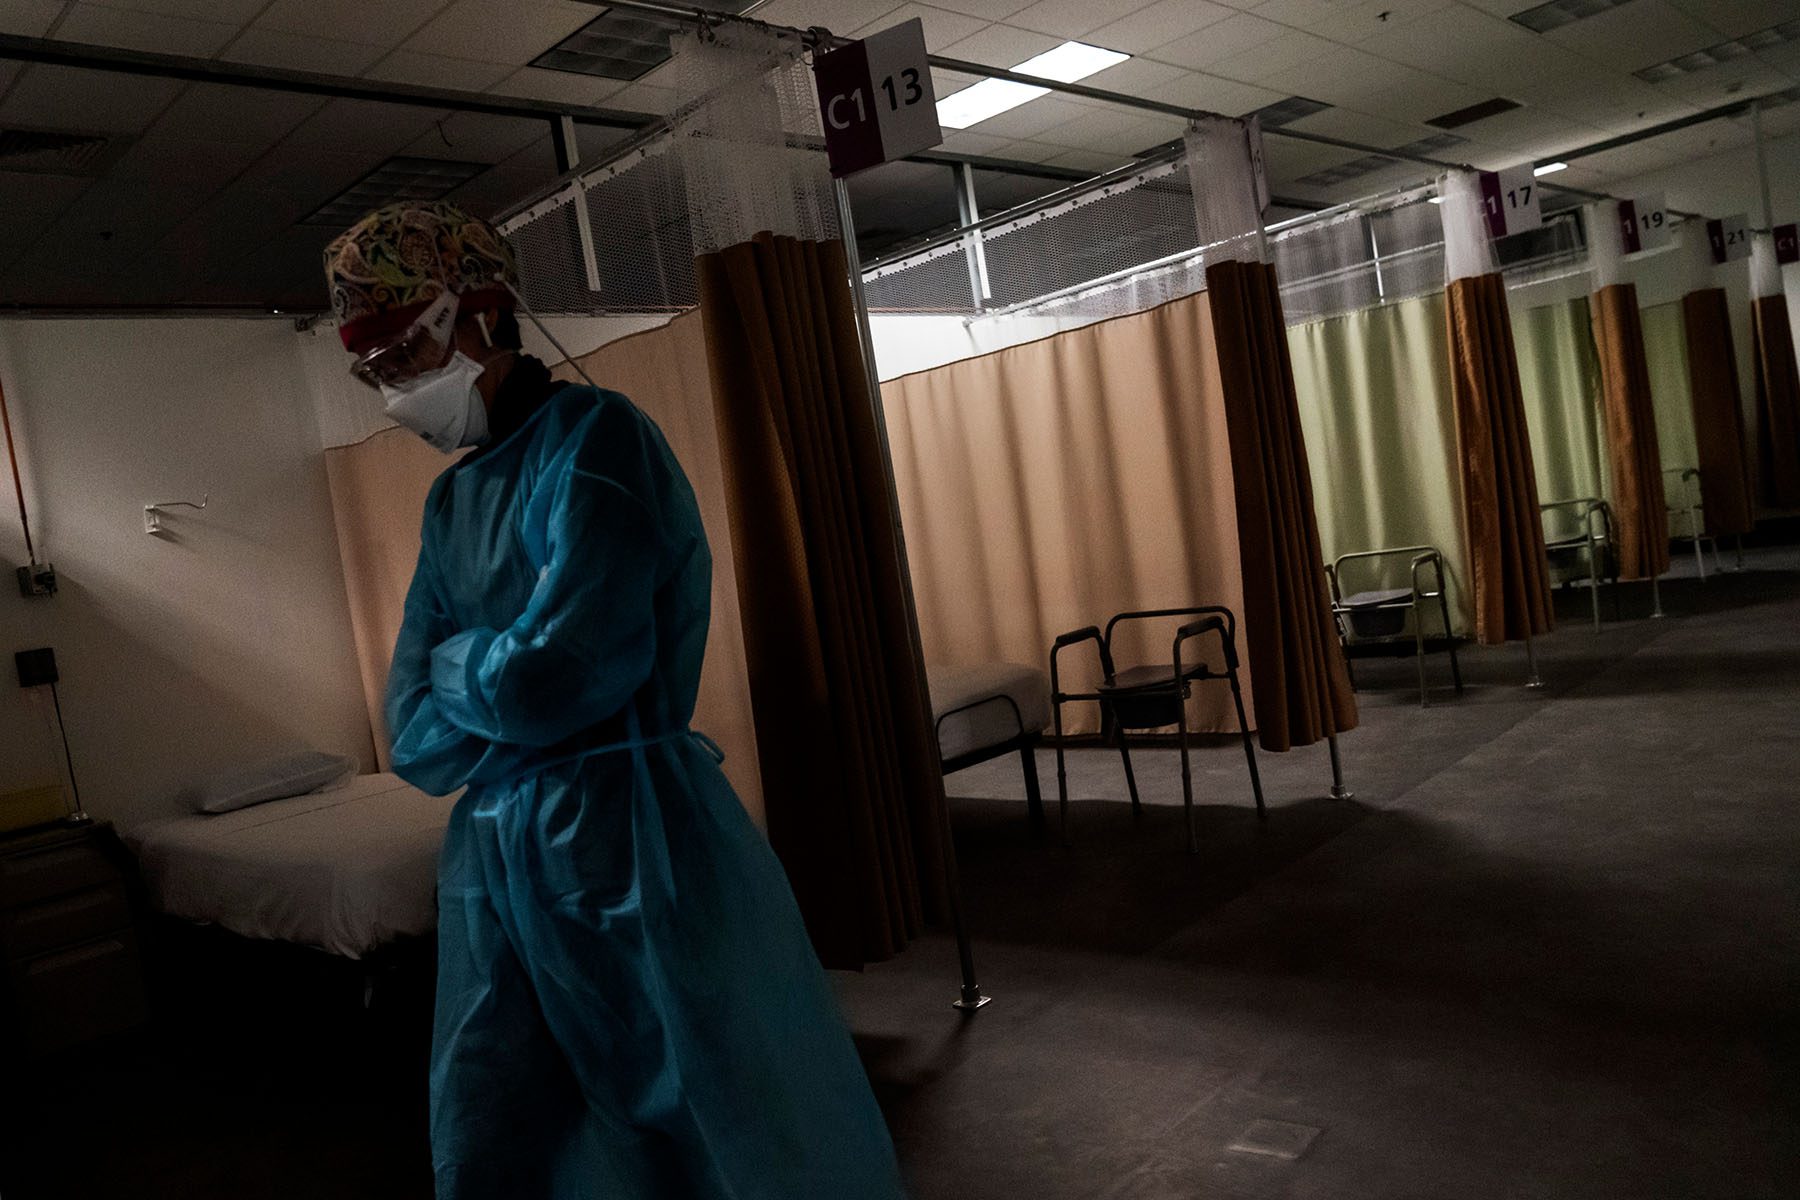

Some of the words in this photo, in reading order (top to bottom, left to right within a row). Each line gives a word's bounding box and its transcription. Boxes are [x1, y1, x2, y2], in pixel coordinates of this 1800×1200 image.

[827, 87, 867, 130] C1
[881, 68, 923, 111] 13
[1508, 186, 1531, 208] 17
[1641, 211, 1663, 229] 19
[1727, 229, 1745, 245] 21
